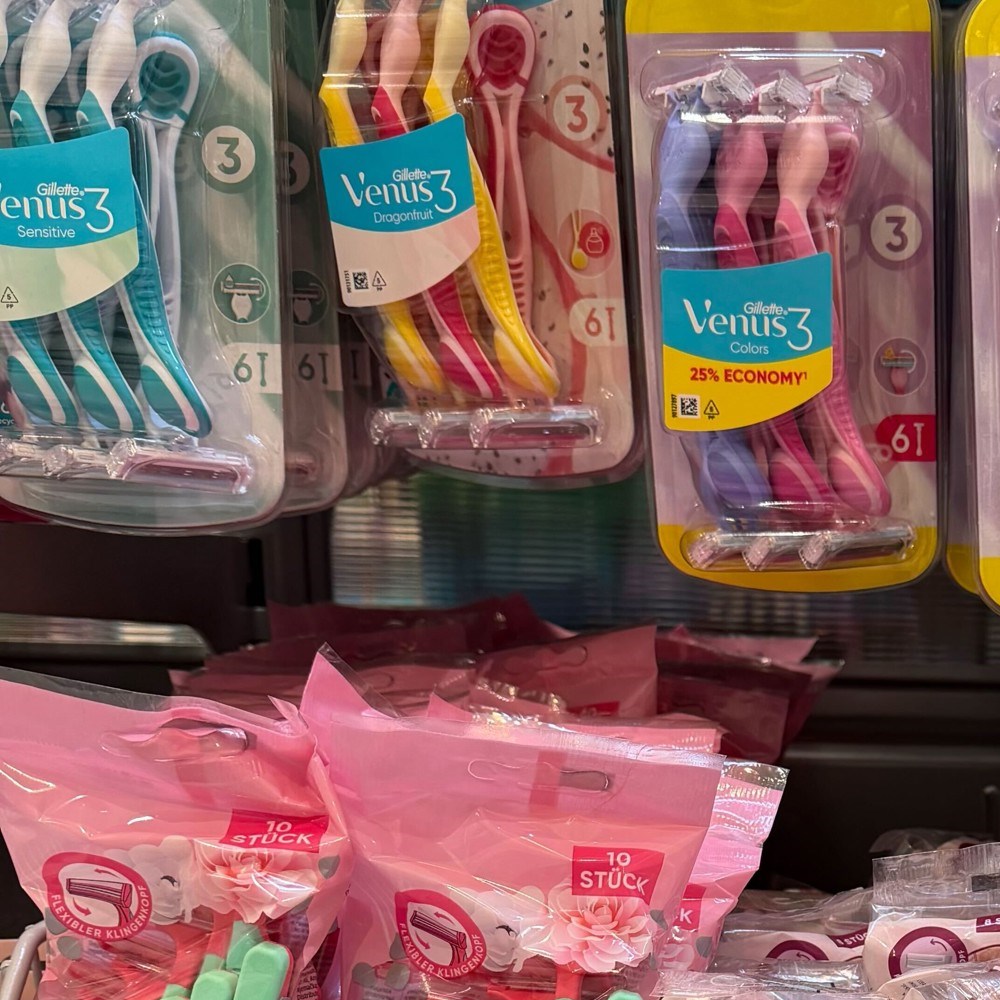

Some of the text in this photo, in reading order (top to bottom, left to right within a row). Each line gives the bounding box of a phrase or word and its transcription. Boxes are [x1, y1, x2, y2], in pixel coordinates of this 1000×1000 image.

[565, 95, 588, 133] 3
[216, 137, 242, 175] 3
[340, 171, 434, 207] Venus
[373, 208, 435, 226] Dragonfruit
[17, 225, 76, 239] Sensitive
[885, 216, 908, 252] 3
[584, 307, 602, 337] 6
[682, 299, 788, 337] Venus
[730, 341, 770, 356] Colors
[233, 353, 254, 384] 6
[690, 367, 720, 383] 25%
[891, 424, 911, 453] 6
[231, 831, 315, 846] STÜCK
[266, 820, 293, 835] 10
[606, 852, 631, 867] 10
[580, 866, 650, 895] STÜCK
[51, 884, 152, 940] FLEXIBLER KLINGENKOPF
[400, 923, 482, 979] FLEXIBLER KLINGENKOPF
